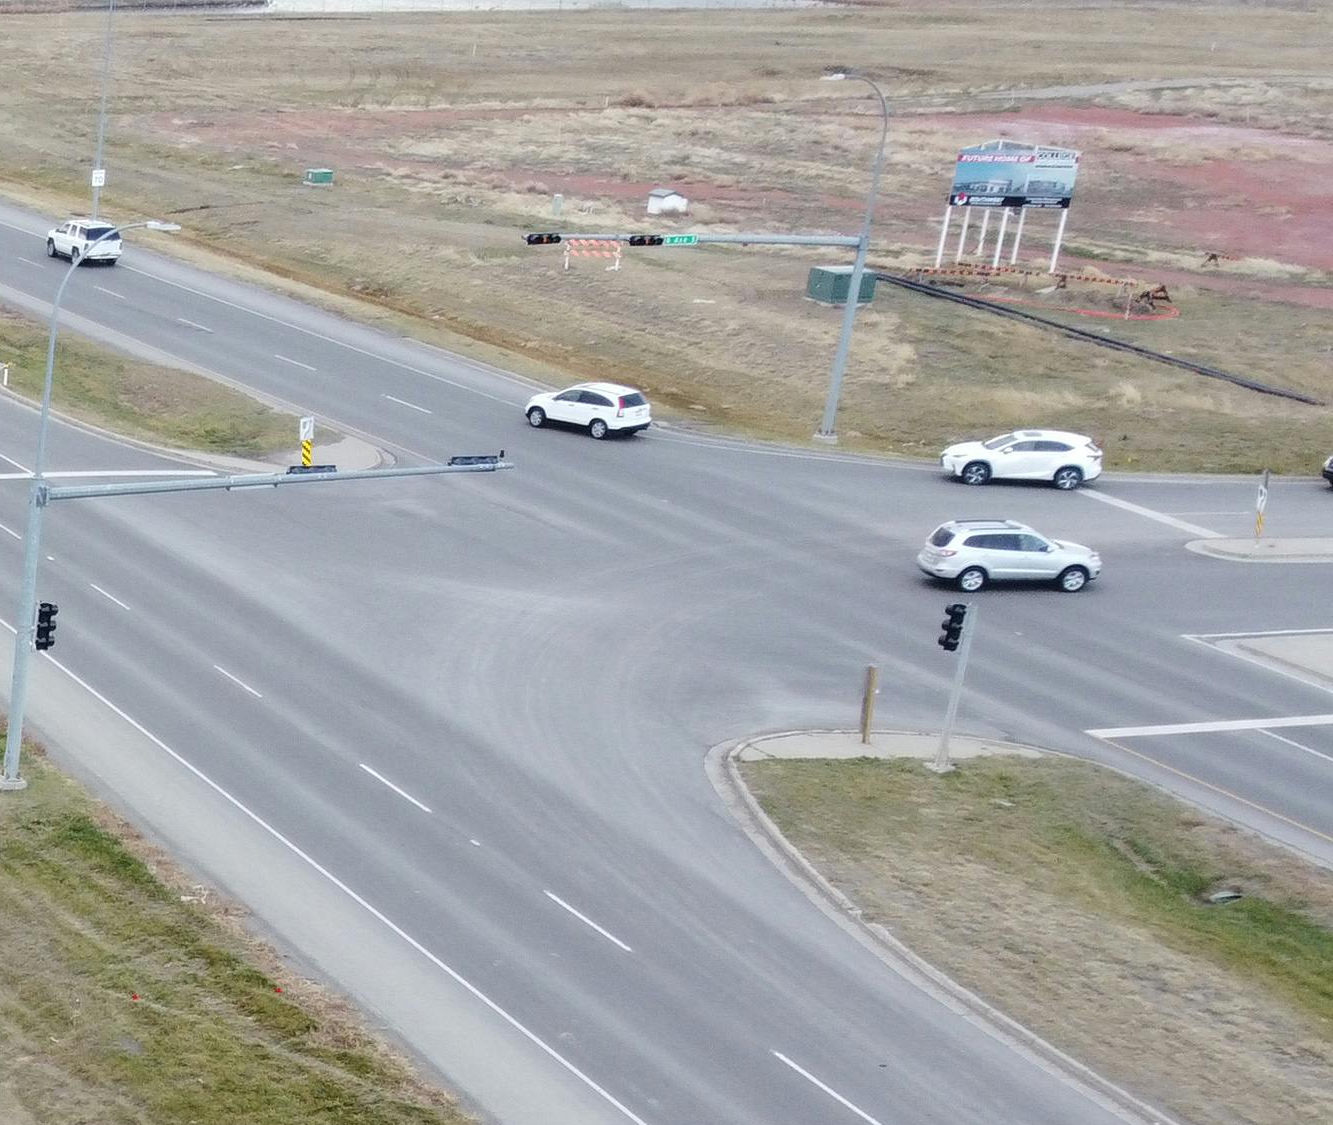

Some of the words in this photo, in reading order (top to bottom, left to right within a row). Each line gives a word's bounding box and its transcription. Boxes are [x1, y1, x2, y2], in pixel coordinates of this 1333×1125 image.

[961, 154, 993, 162] FUTURE
[994, 155, 1019, 163] HOME
[1019, 155, 1032, 163] OF
